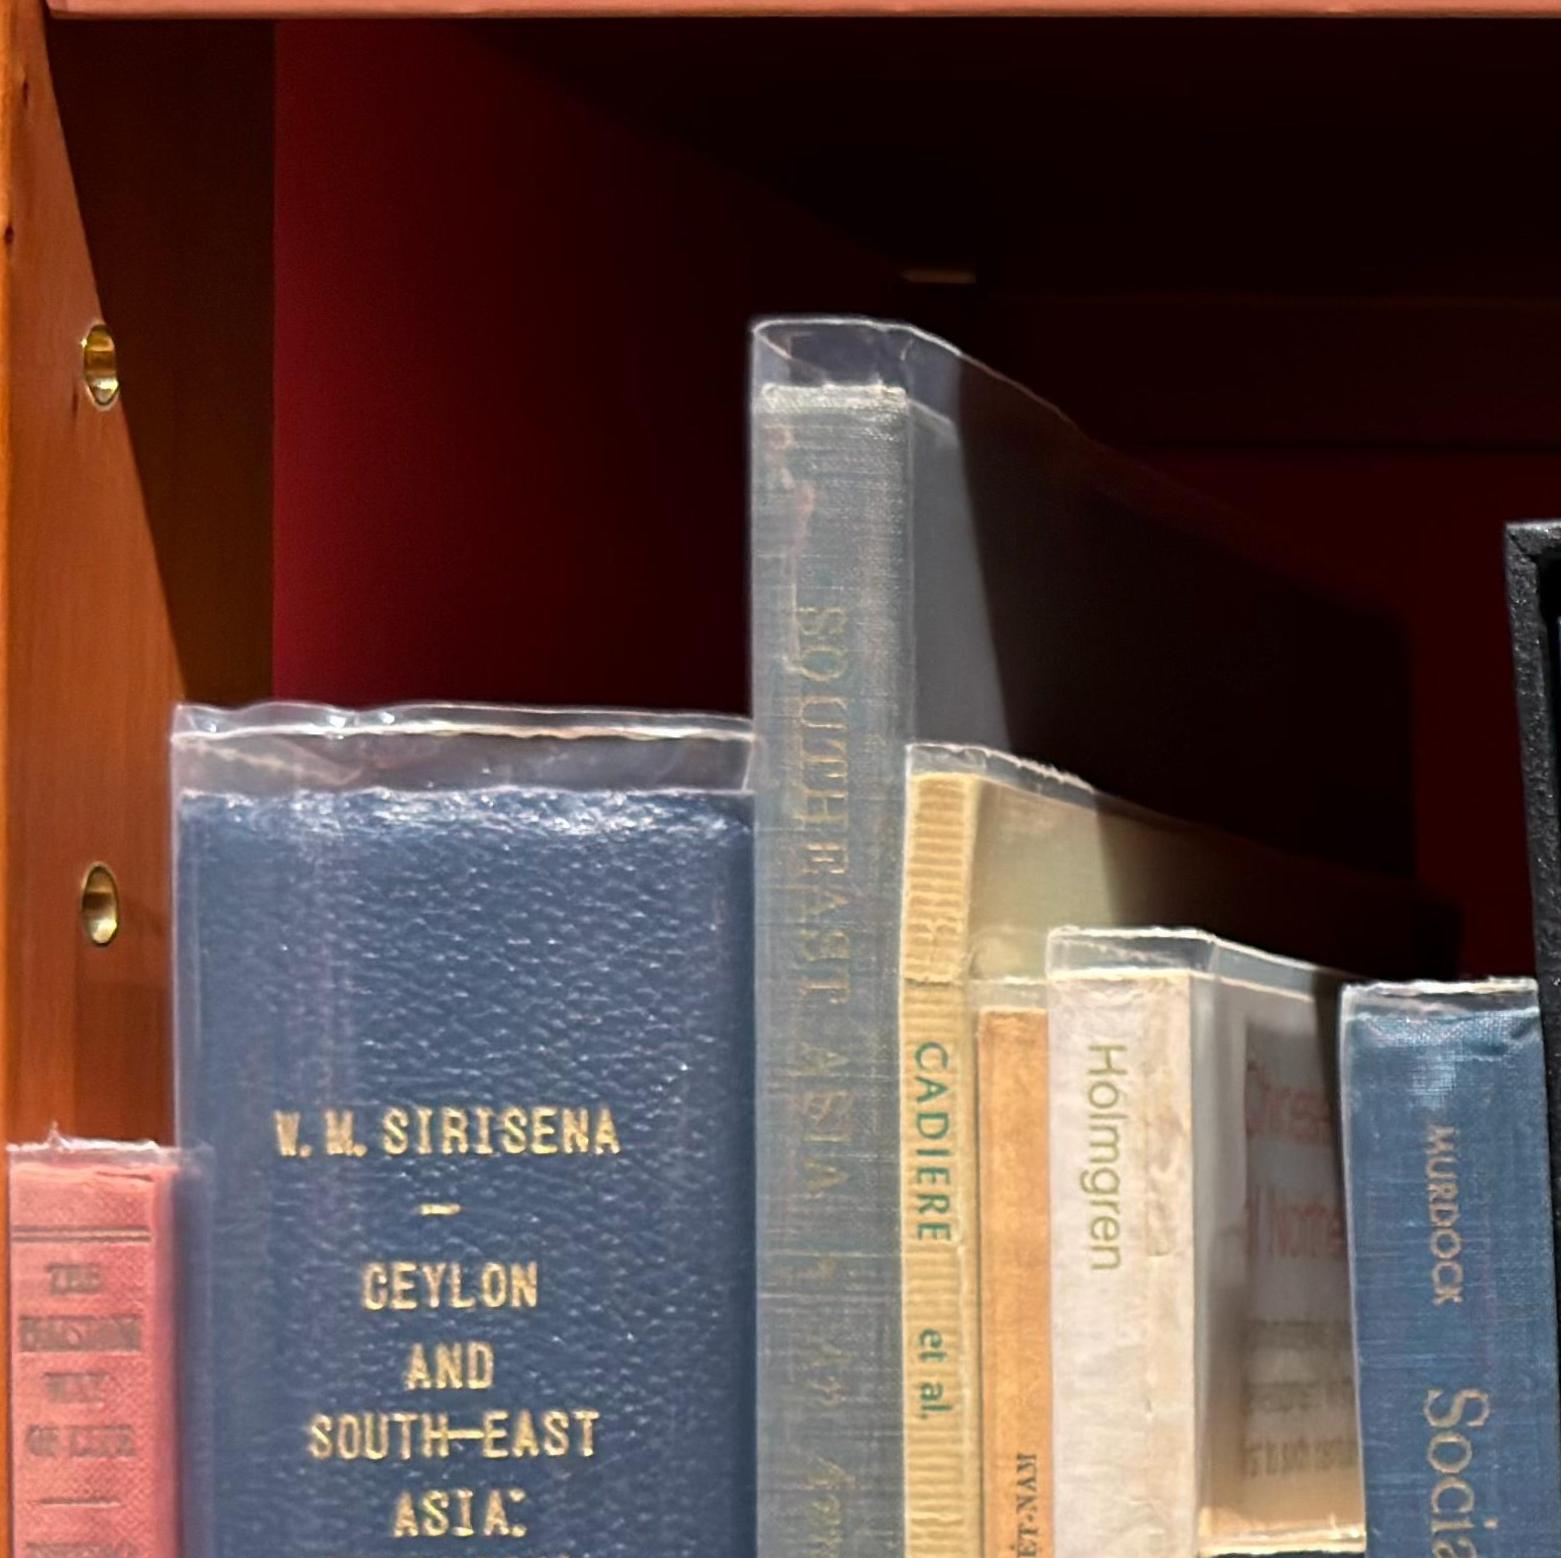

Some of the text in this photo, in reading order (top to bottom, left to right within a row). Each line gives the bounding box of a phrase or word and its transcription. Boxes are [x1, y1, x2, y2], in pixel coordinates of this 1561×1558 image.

[916, 1040, 952, 1422] CADIERE et al.
[1080, 1043, 1130, 1271] Holmgren
[1425, 1124, 1467, 1306] MURDOCK
[310, 1409, 601, 1461] SOUTH-EAST
[405, 1341, 495, 1391] AND
